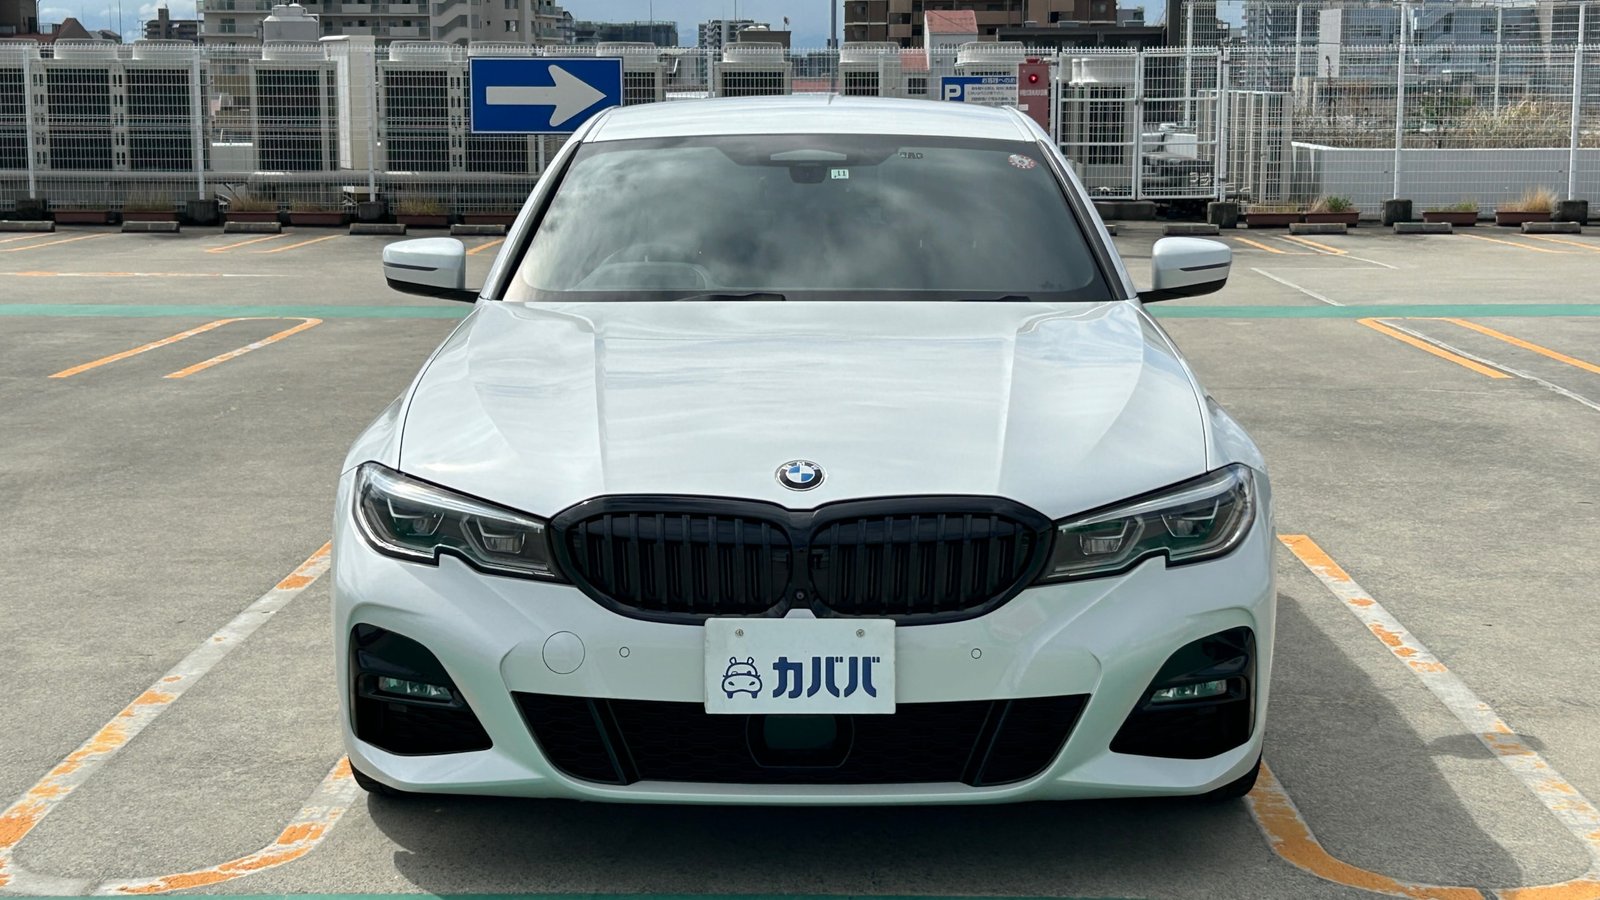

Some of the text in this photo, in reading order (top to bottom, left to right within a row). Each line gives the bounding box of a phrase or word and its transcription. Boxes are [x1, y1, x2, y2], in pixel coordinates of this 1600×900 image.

[944, 84, 962, 101] P
[781, 460, 820, 471] BMW
[773, 656, 880, 699] カババ
